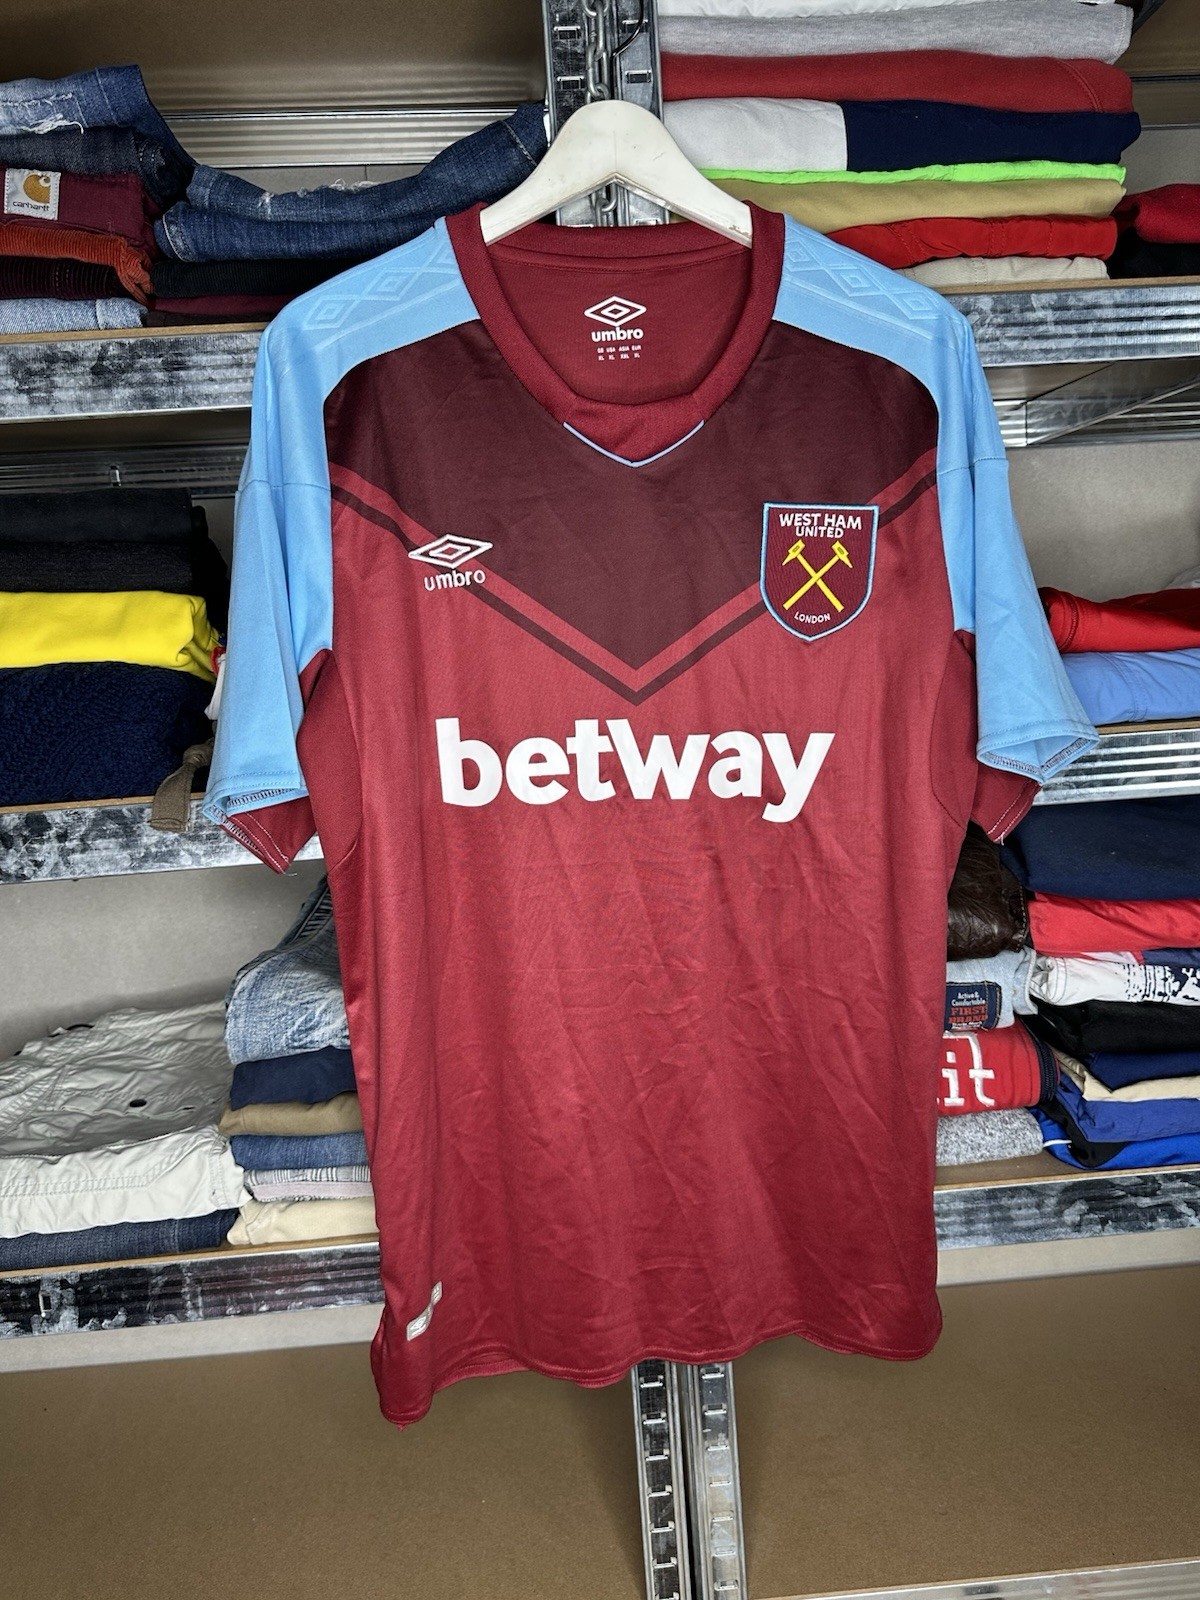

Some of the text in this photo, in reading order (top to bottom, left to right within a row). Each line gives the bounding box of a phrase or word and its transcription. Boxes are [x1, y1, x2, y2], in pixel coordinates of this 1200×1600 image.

[12, 201, 50, 211] carhartt
[591, 326, 644, 342] umbro
[779, 513, 862, 531] WEST HAM
[795, 525, 844, 539] UNITED
[424, 569, 486, 592] umbro
[794, 611, 831, 624] LONDON
[435, 717, 836, 823] betway
[951, 1006, 987, 1016] FIRST
[948, 1014, 988, 1024] BRAND
